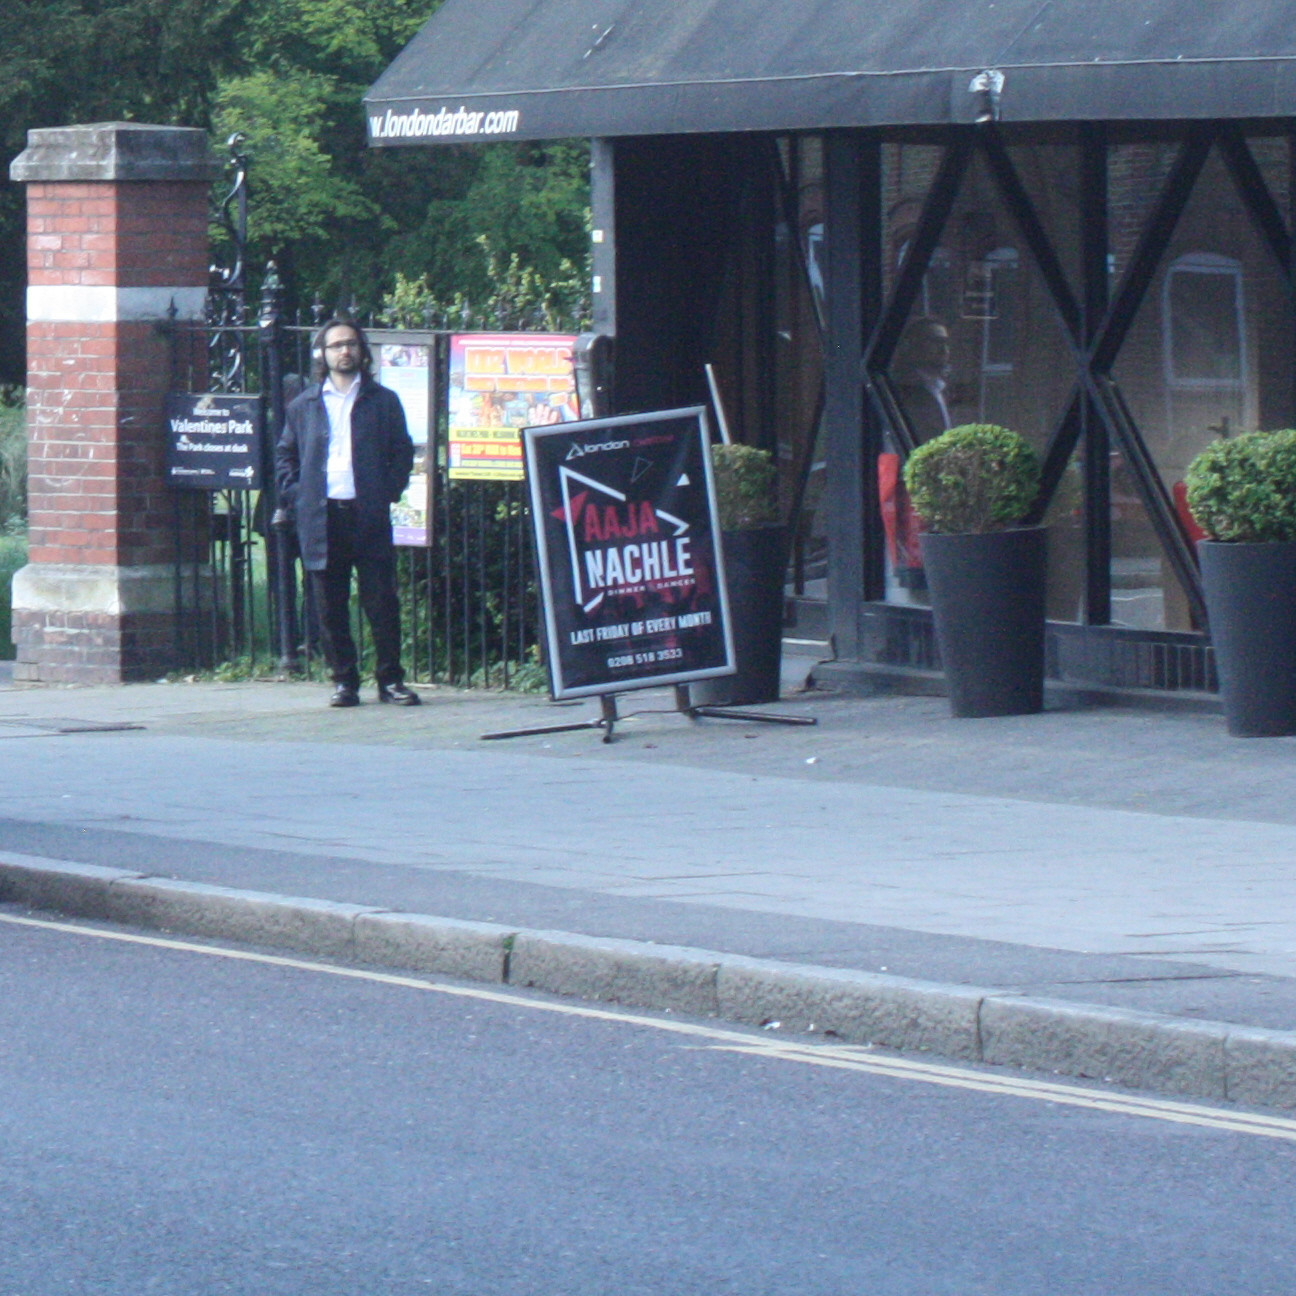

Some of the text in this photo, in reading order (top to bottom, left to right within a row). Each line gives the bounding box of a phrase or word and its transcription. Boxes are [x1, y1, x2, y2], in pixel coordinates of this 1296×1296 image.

[170, 418, 254, 434] Valentines Park
[188, 442, 203, 452] Park
[584, 440, 630, 453] london
[585, 500, 659, 542] AAJA
[584, 536, 694, 589] NACHLE
[570, 611, 712, 645] LAST FRIDAY OF EVERY MONTH
[635, 652, 655, 664] 518
